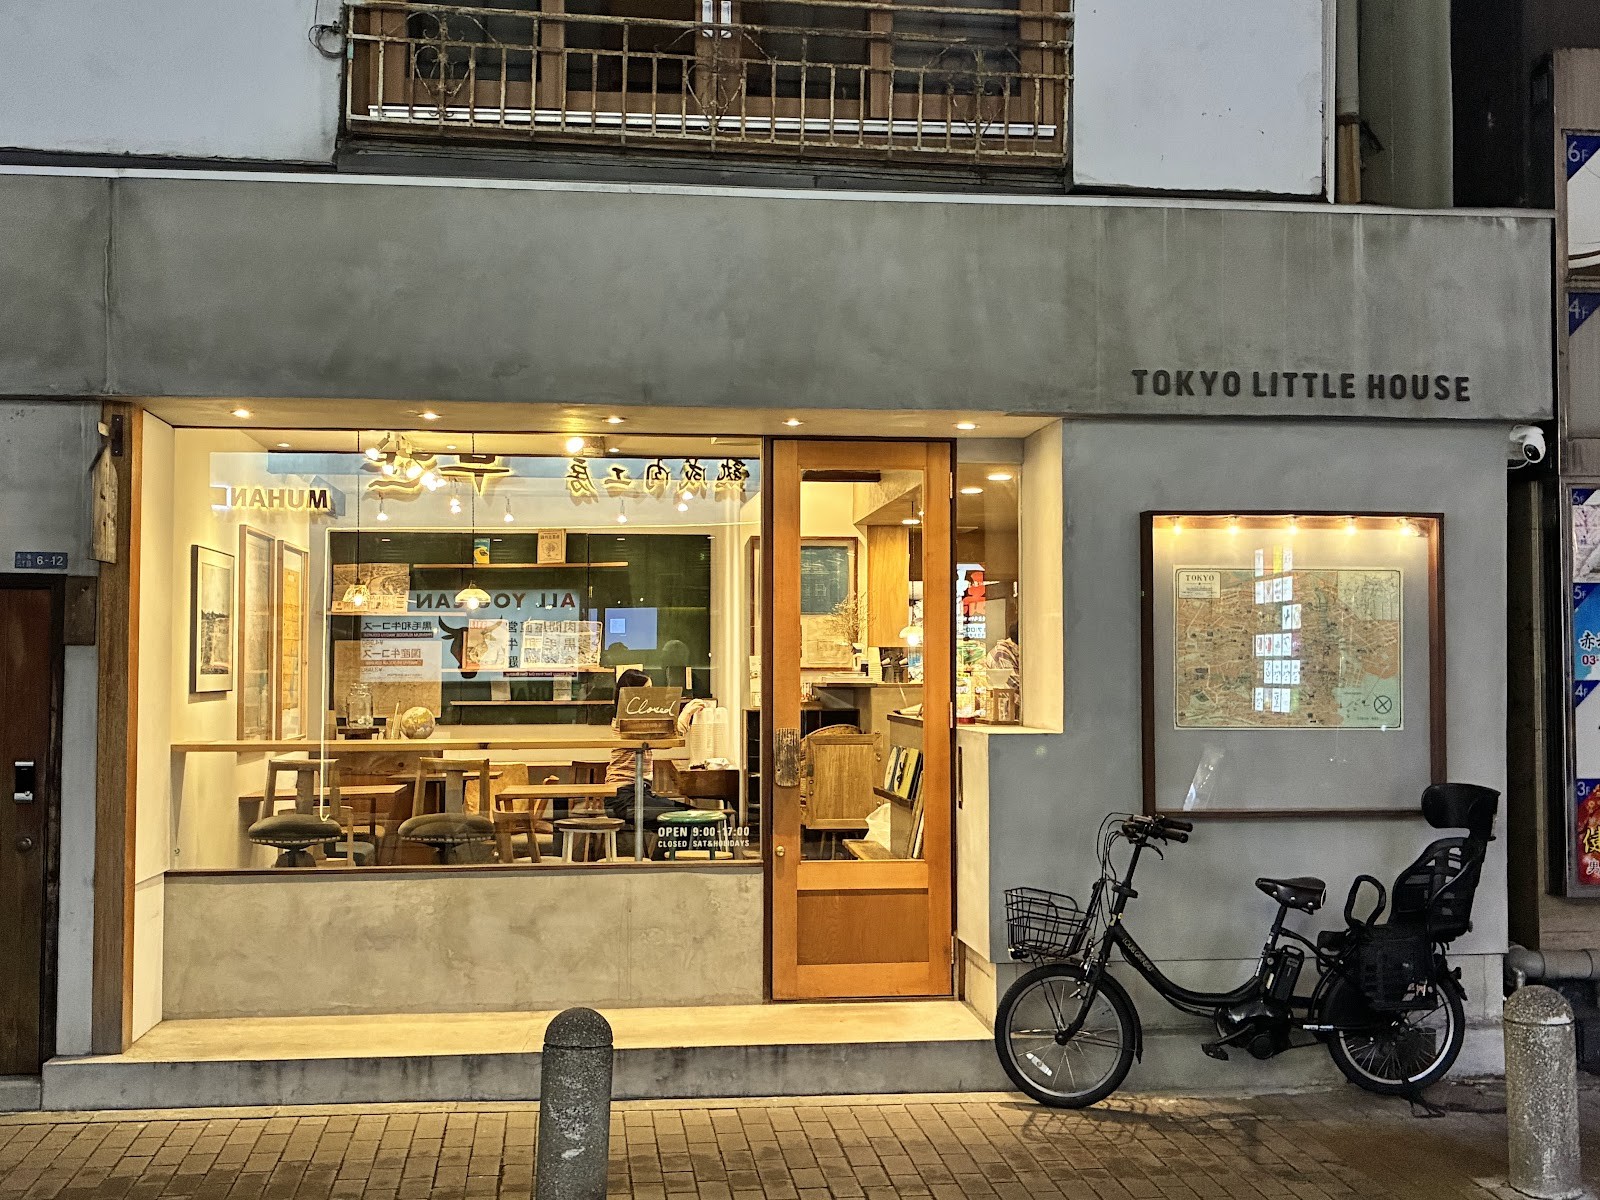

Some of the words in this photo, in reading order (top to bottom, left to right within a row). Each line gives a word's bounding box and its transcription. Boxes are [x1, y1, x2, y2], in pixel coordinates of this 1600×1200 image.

[1568, 141, 1589, 162] 6F
[1568, 298, 1589, 320] 4F
[1131, 369, 1241, 397] TOKYO
[1252, 371, 1356, 399] LITTLE
[1367, 374, 1471, 402] HOUSE
[36, 555, 64, 566] 6-12
[1185, 574, 1215, 582] TOKYO
[1573, 585, 1587, 600] 5F
[1580, 631, 1600, 650] 赤
[1575, 684, 1588, 698] 4F
[626, 696, 677, 717] Closed
[1577, 781, 1591, 796] 3F
[657, 826, 688, 837] OPEN
[657, 840, 688, 848] CLOSED
